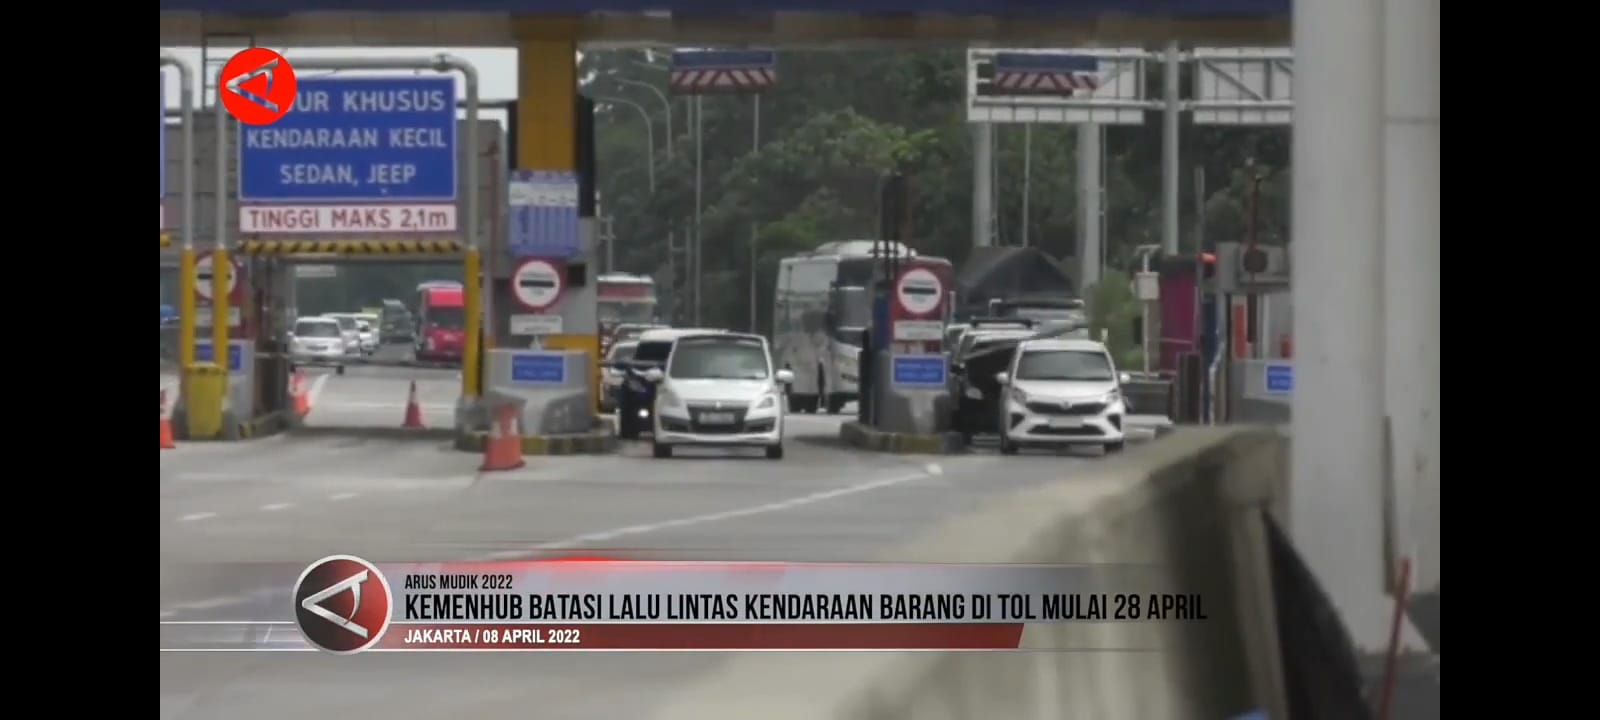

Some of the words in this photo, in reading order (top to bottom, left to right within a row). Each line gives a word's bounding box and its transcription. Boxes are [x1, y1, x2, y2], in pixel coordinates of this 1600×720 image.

[344, 90, 446, 112] KHUSUS
[246, 128, 377, 148] KENDARAAN
[390, 128, 446, 148] KECIL
[280, 164, 359, 186] SEDAN,
[366, 164, 416, 183] JEEP
[250, 210, 319, 228] TINGGI
[331, 210, 390, 227] MAKS
[400, 209, 448, 230] 2,1m
